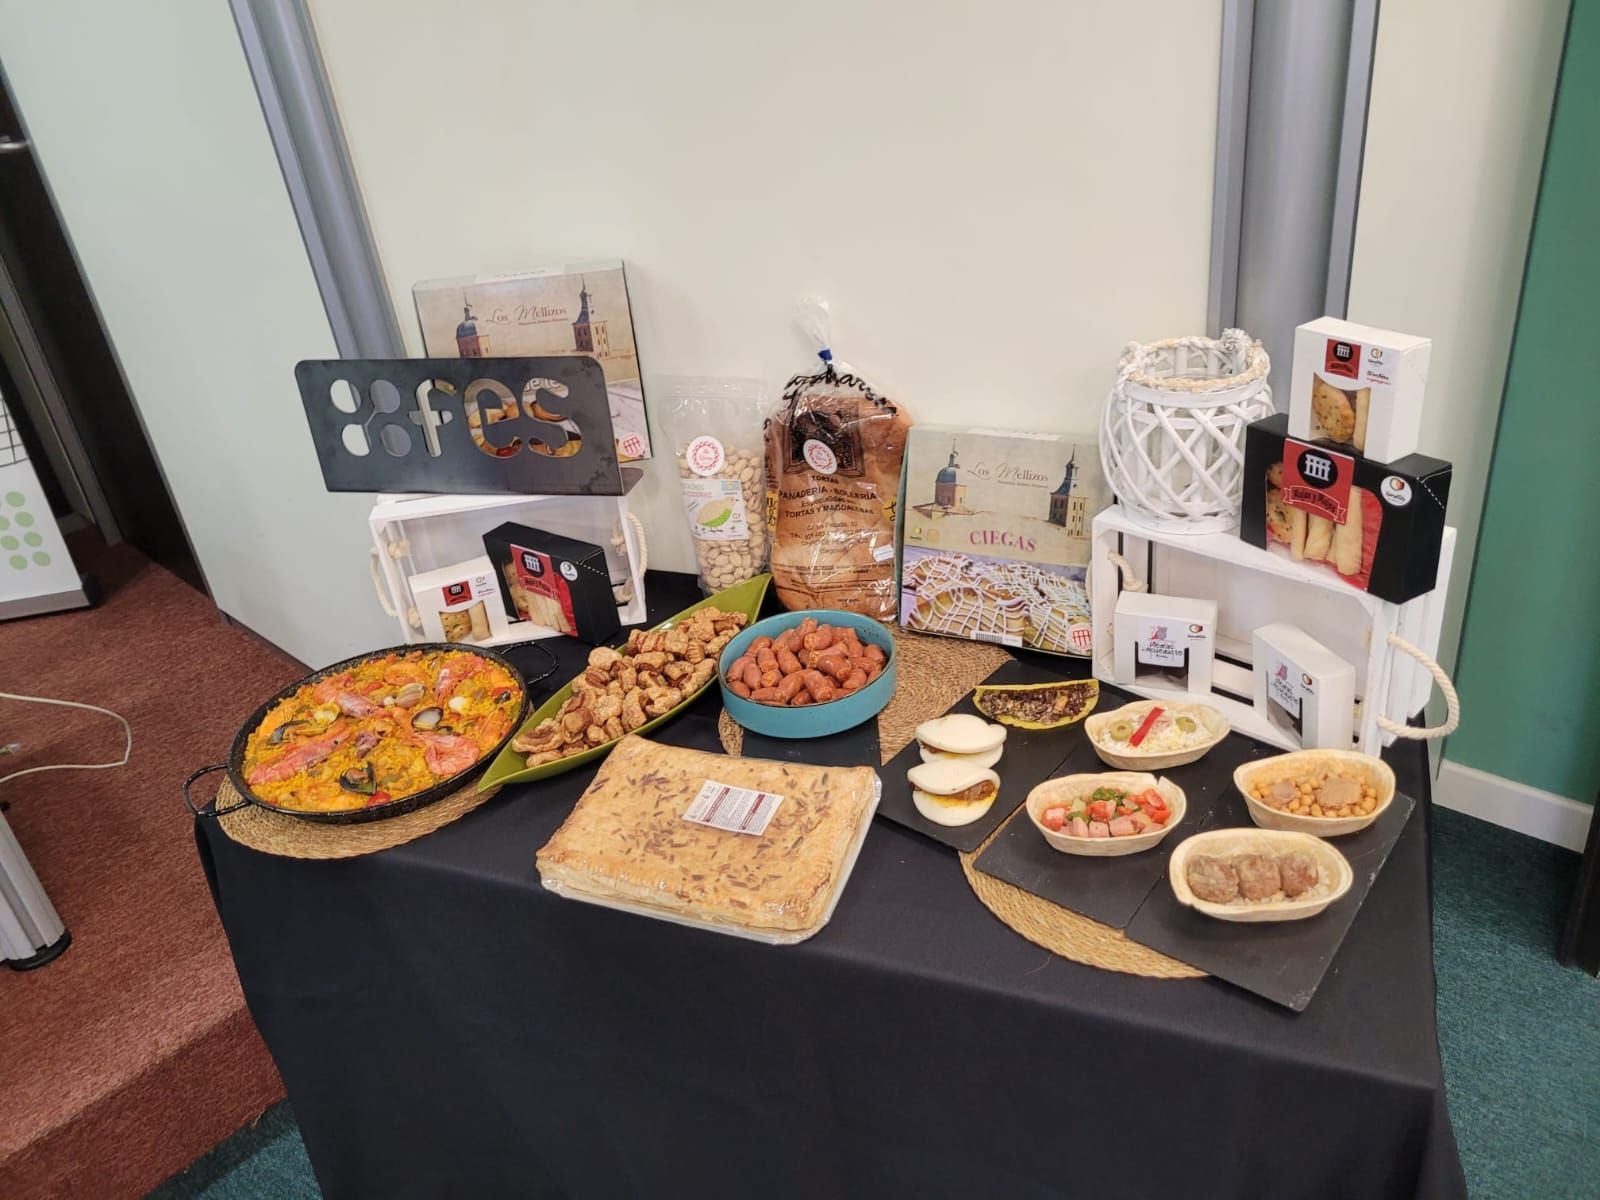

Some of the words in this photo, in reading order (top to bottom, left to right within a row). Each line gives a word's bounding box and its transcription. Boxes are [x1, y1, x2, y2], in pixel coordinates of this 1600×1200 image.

[485, 308, 512, 326] Los
[514, 304, 567, 321] Mellizos
[967, 461, 992, 481] Los
[996, 462, 1049, 482] Mellizos
[784, 508, 815, 520] TORTAS
[969, 529, 1038, 552] CIEGAS
